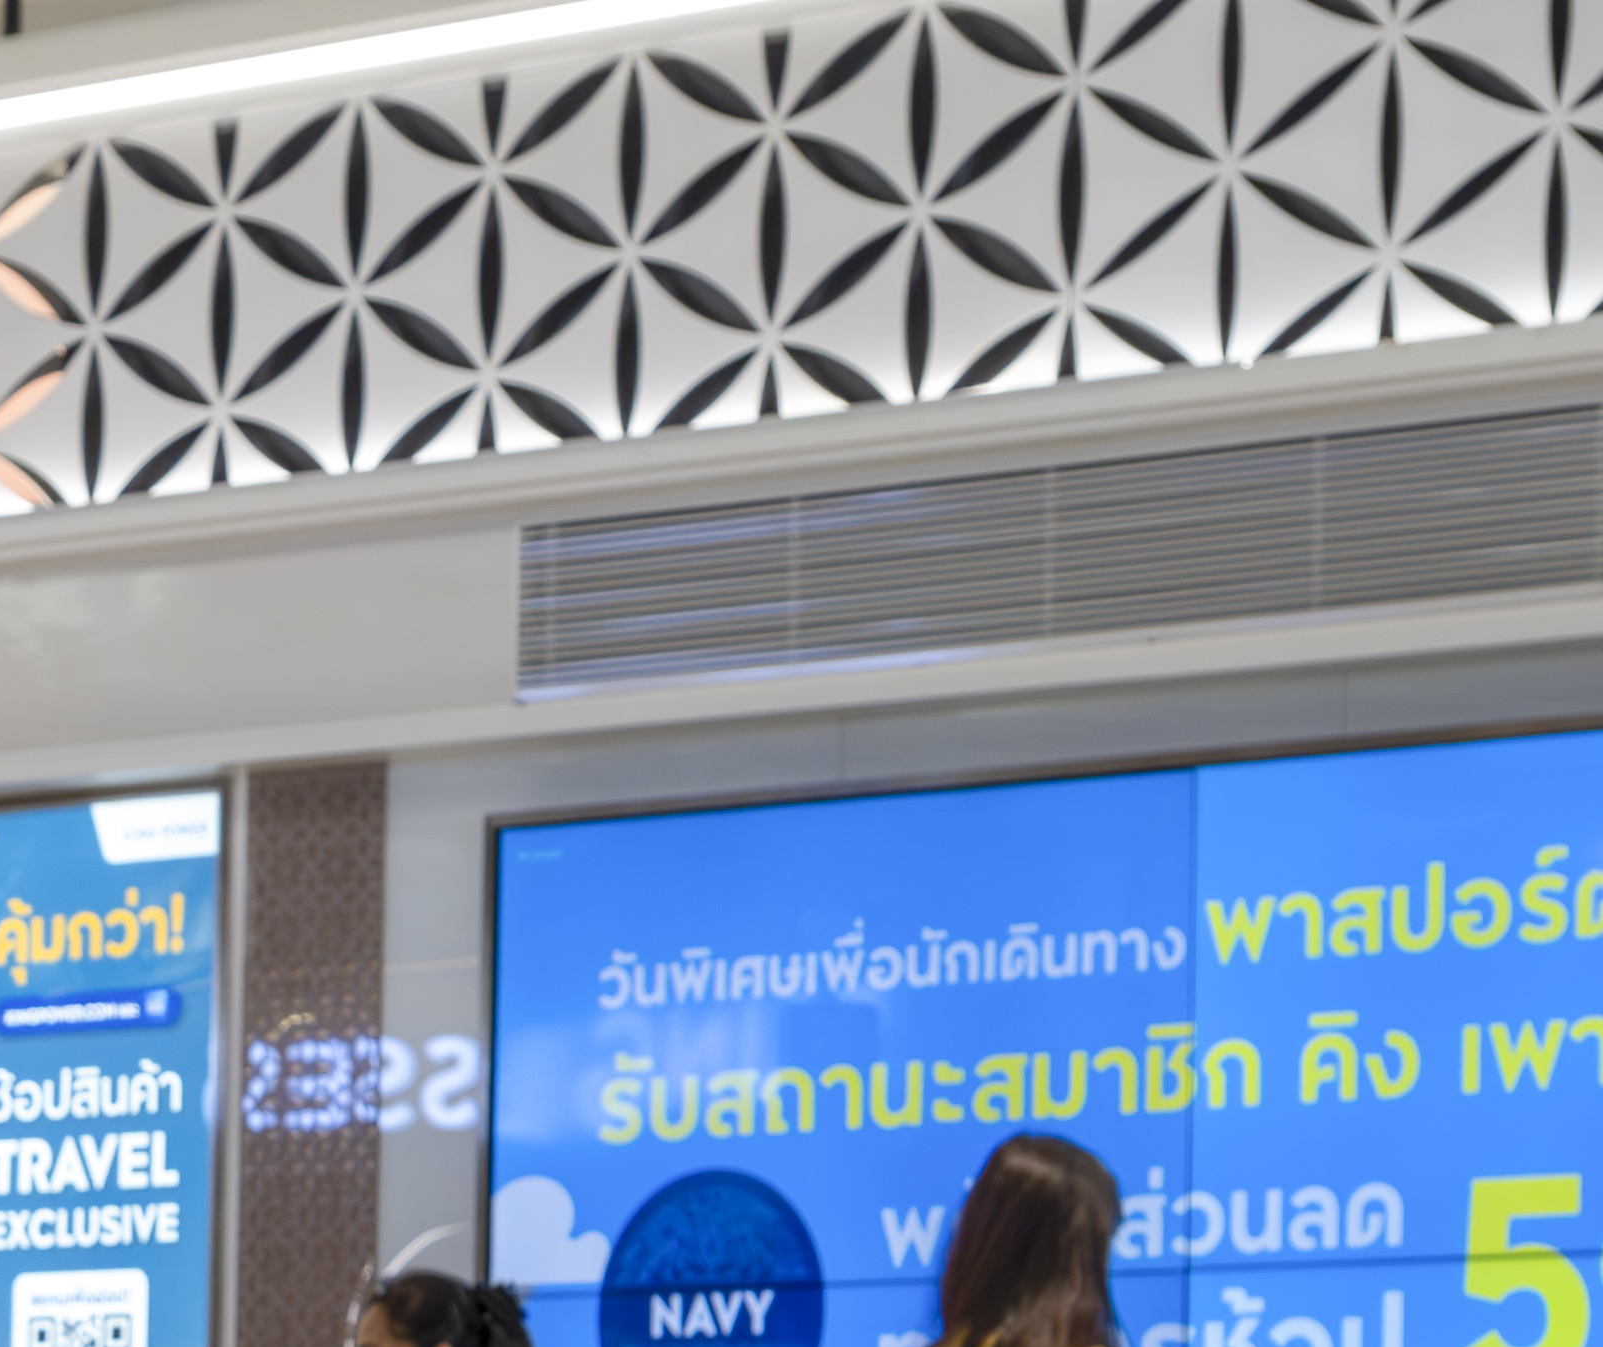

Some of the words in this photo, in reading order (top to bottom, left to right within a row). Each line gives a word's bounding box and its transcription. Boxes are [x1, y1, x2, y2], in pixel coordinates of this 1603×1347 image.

[597, 916, 1188, 1010] วันพิเศษเพื่อนักเดินทาง
[599, 1020, 1263, 1147] รับสถานะสมาชิก
[1299, 1008, 1422, 1106] คิง
[648, 1287, 776, 1341] NAVY
